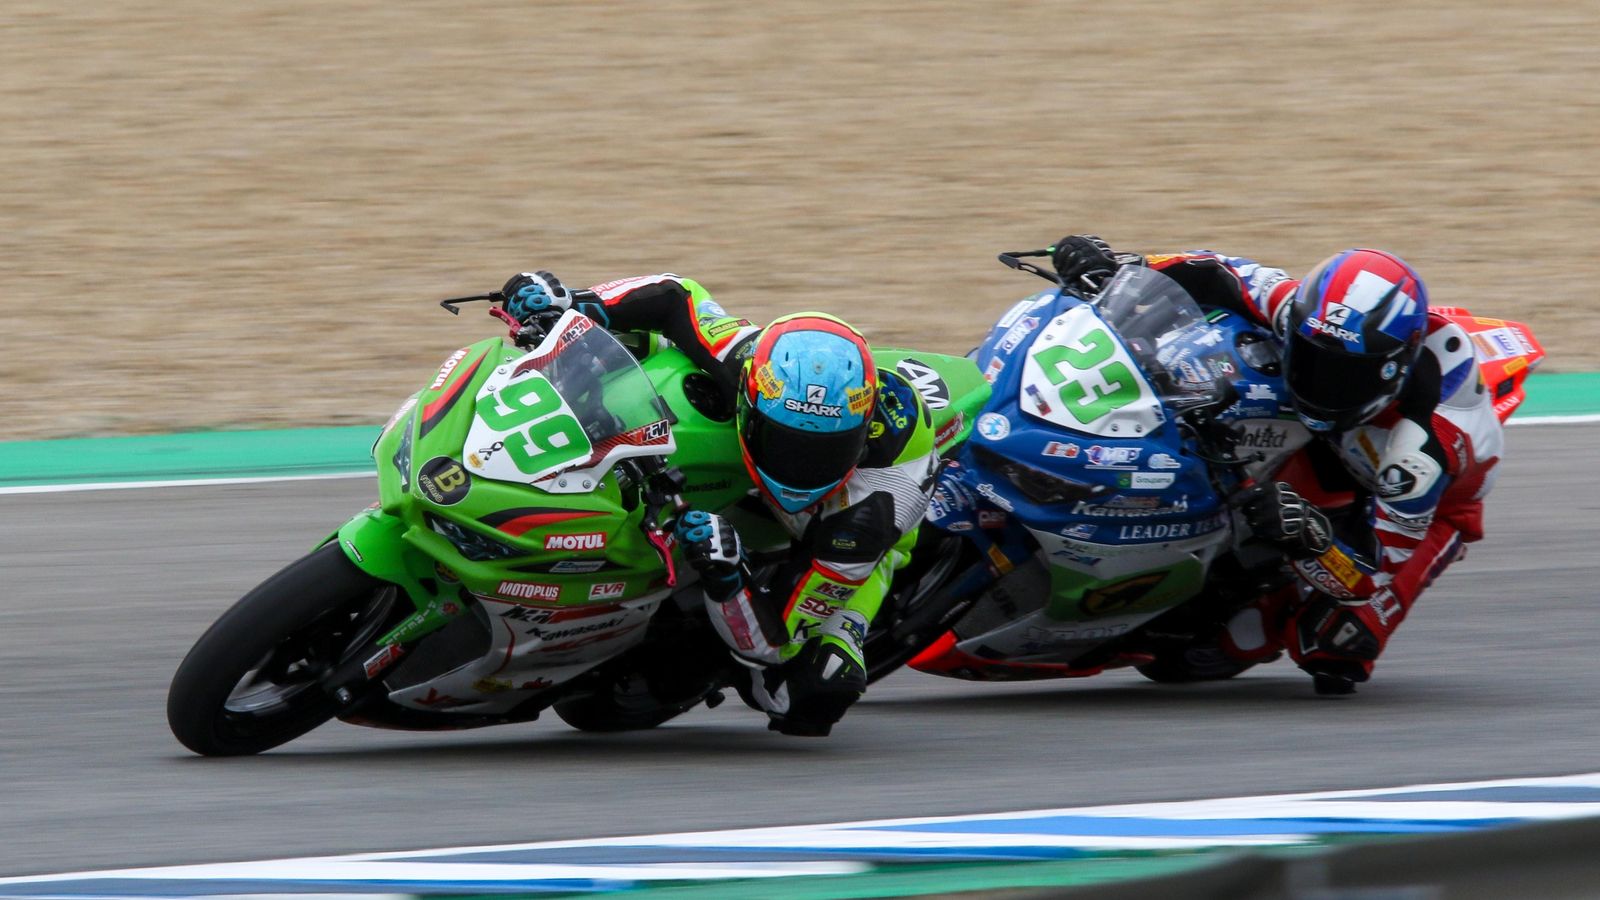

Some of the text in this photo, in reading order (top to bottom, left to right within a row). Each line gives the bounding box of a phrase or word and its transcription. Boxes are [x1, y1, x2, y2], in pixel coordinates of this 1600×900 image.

[1305, 316, 1361, 343] SHARK
[1032, 328, 1141, 425] 23
[785, 399, 841, 417] SHARK
[476, 376, 593, 475] 99
[434, 464, 466, 493] B
[546, 534, 605, 551] MOTUL
[1118, 523, 1192, 541] LEADER
[498, 581, 560, 599] MOTOPLUS
[591, 583, 625, 596] EVR
[525, 613, 630, 642] Kawasaki
